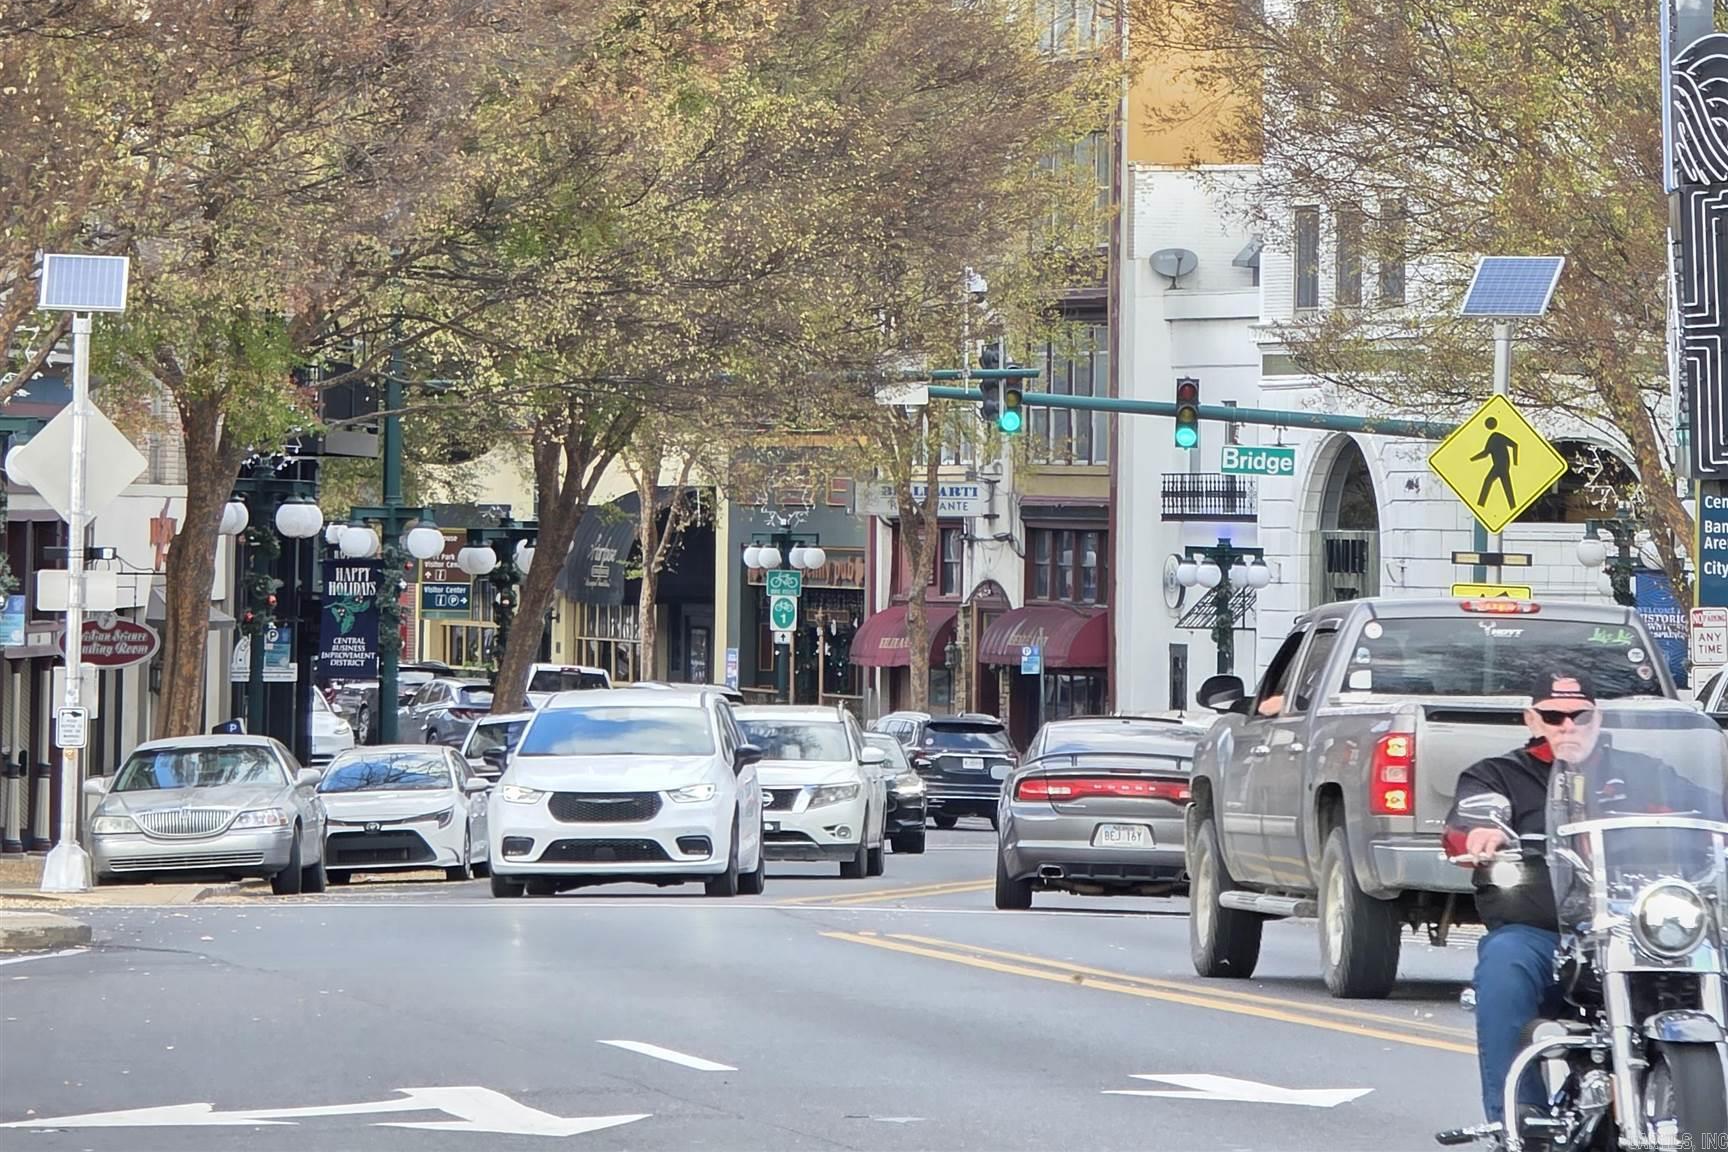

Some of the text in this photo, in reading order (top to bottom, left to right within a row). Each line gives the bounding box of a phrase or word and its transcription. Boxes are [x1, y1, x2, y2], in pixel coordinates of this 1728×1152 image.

[1222, 448, 1293, 474] Bridge
[939, 486, 978, 497] ARTI
[1704, 495, 1728, 509] Cen
[1704, 520, 1728, 534] Ban
[1704, 536, 1727, 550] Are
[335, 567, 371, 582] HAPPY
[833, 556, 854, 586] pub
[1704, 561, 1728, 578] City
[328, 581, 377, 596] HOLIDAYS
[1692, 612, 1703, 625] NO
[333, 637, 366, 645] CENTRAL
[1698, 632, 1722, 642] ANY
[115, 641, 149, 655] Room
[320, 651, 376, 659] IMPROVEMENT
[331, 644, 366, 652] BUSINESS
[1698, 644, 1723, 654] TIME
[329, 659, 366, 667] DISTRICT
